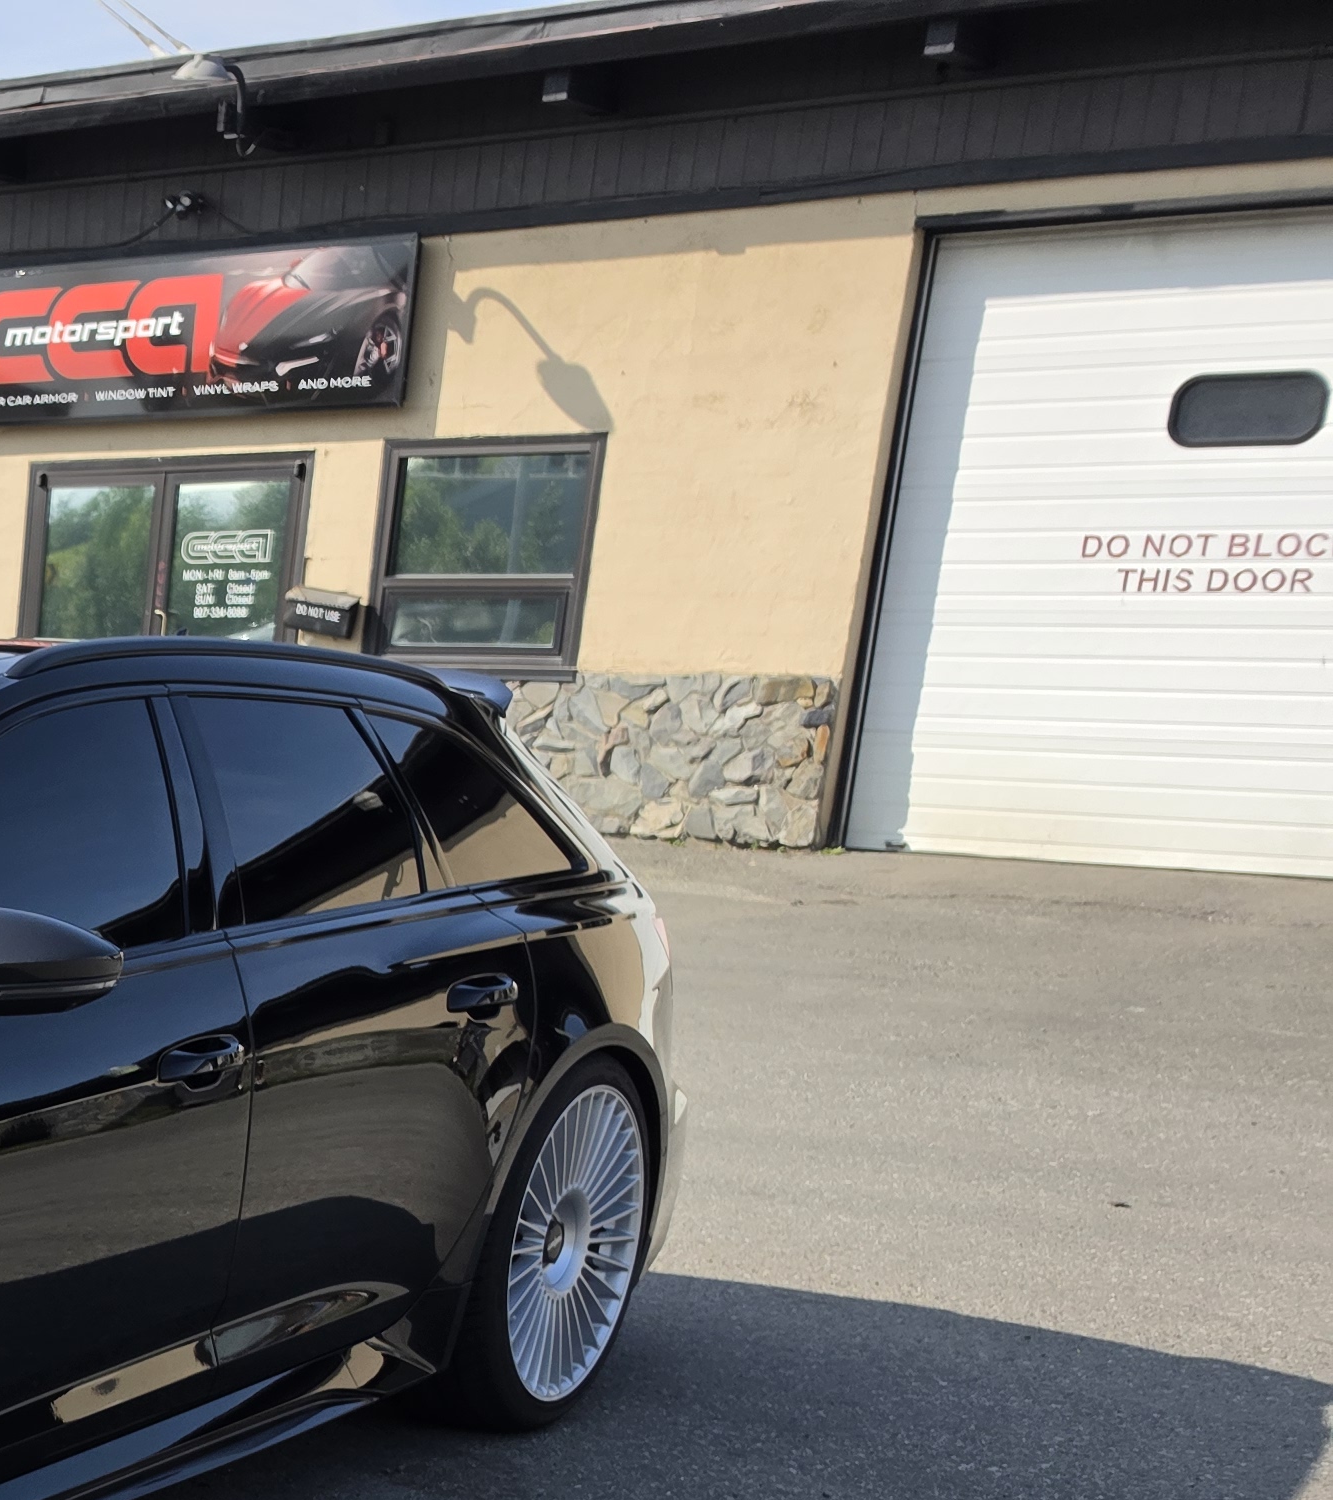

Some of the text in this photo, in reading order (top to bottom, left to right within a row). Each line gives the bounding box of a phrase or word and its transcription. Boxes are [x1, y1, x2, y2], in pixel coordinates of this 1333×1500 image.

[4, 310, 185, 347] motorsport
[7, 394, 32, 407] CAR
[33, 392, 79, 405] ARMOR
[95, 387, 147, 401] WINDOW
[147, 386, 176, 398] TINT
[193, 384, 231, 396] VINYL
[232, 380, 279, 394] WRAPS
[298, 377, 329, 391] AND
[330, 375, 373, 389] MORE
[1081, 532, 1333, 558] DO NOT BLOC
[195, 582, 255, 594] SAT Closed
[1117, 568, 1314, 592] THIS DOOR
[194, 593, 255, 605] SUN Closed
[296, 603, 341, 622] DO NOT USE
